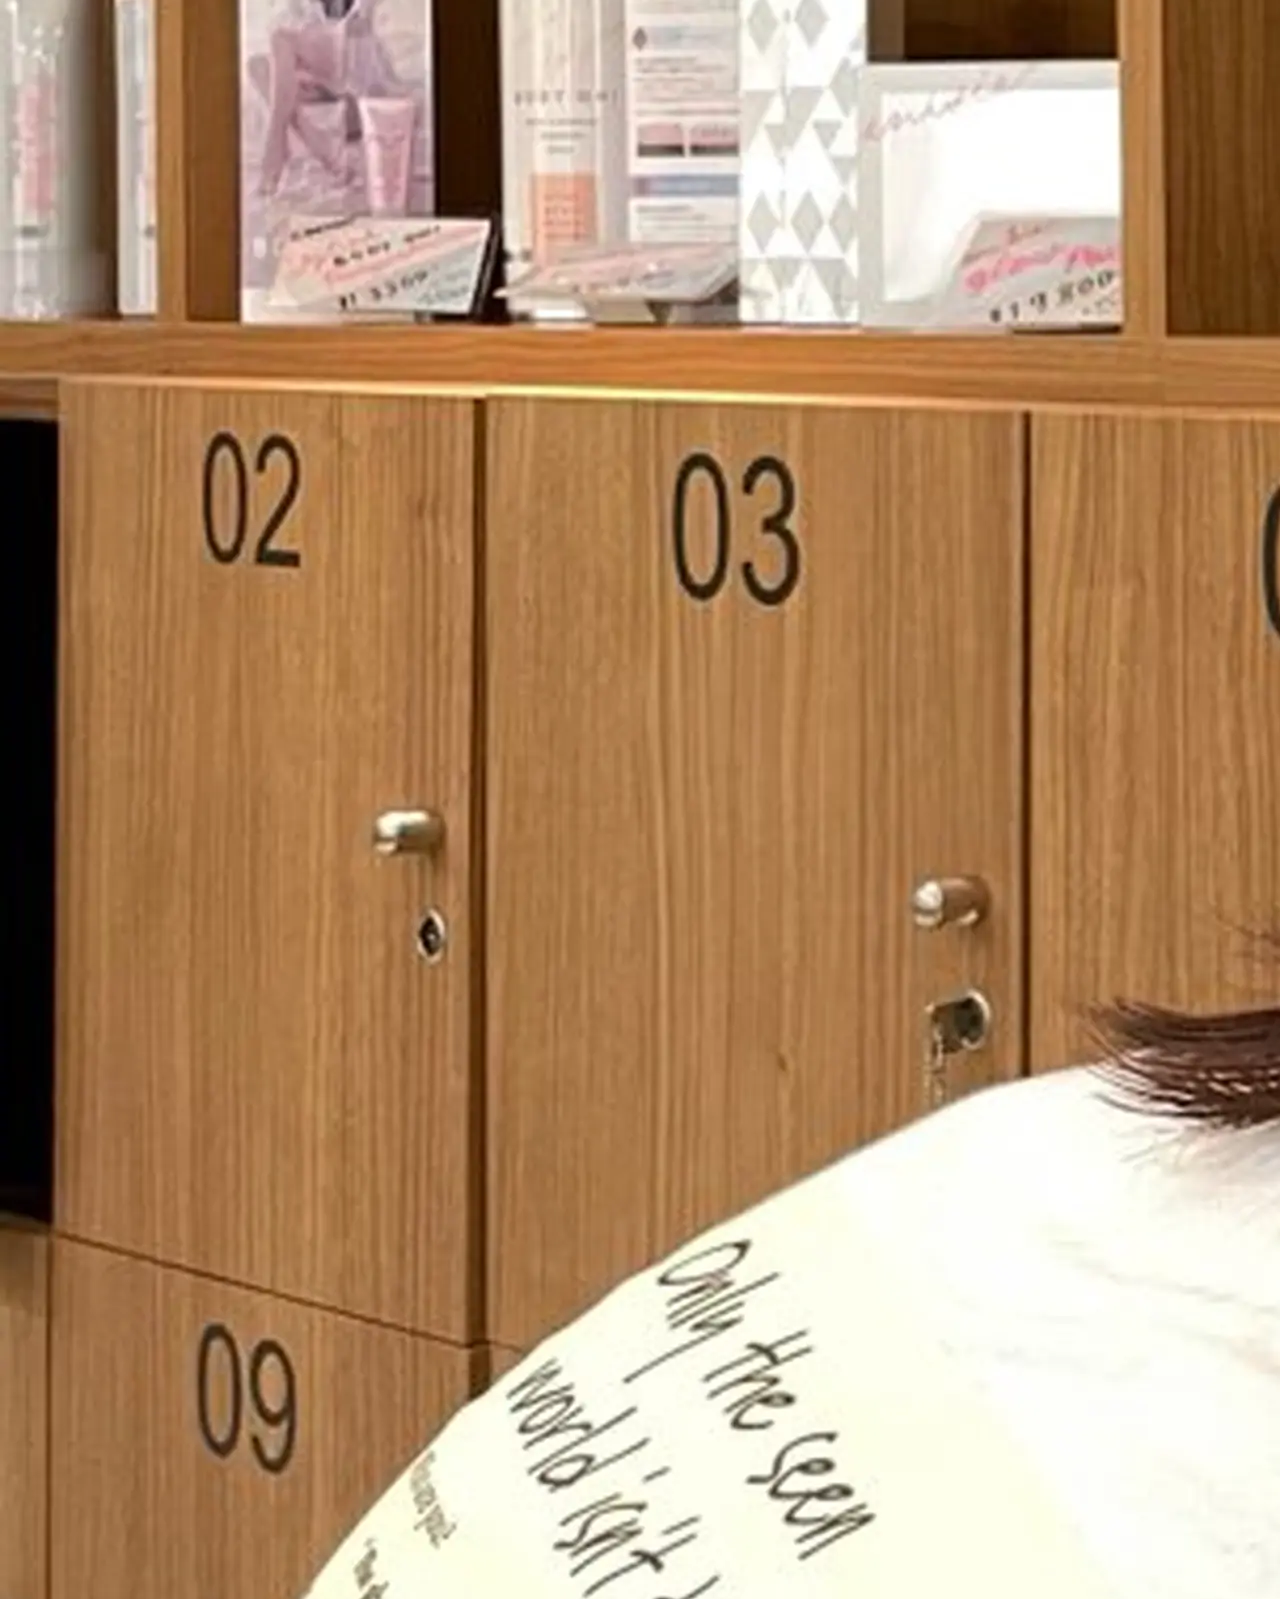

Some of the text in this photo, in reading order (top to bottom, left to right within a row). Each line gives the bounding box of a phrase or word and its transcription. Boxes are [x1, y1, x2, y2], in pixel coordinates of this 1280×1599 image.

[203, 431, 300, 568] 02
[673, 453, 800, 606] 03
[197, 1324, 296, 1474] 09
[507, 1358, 652, 1494] world
[623, 1239, 876, 1561] Only the seen
